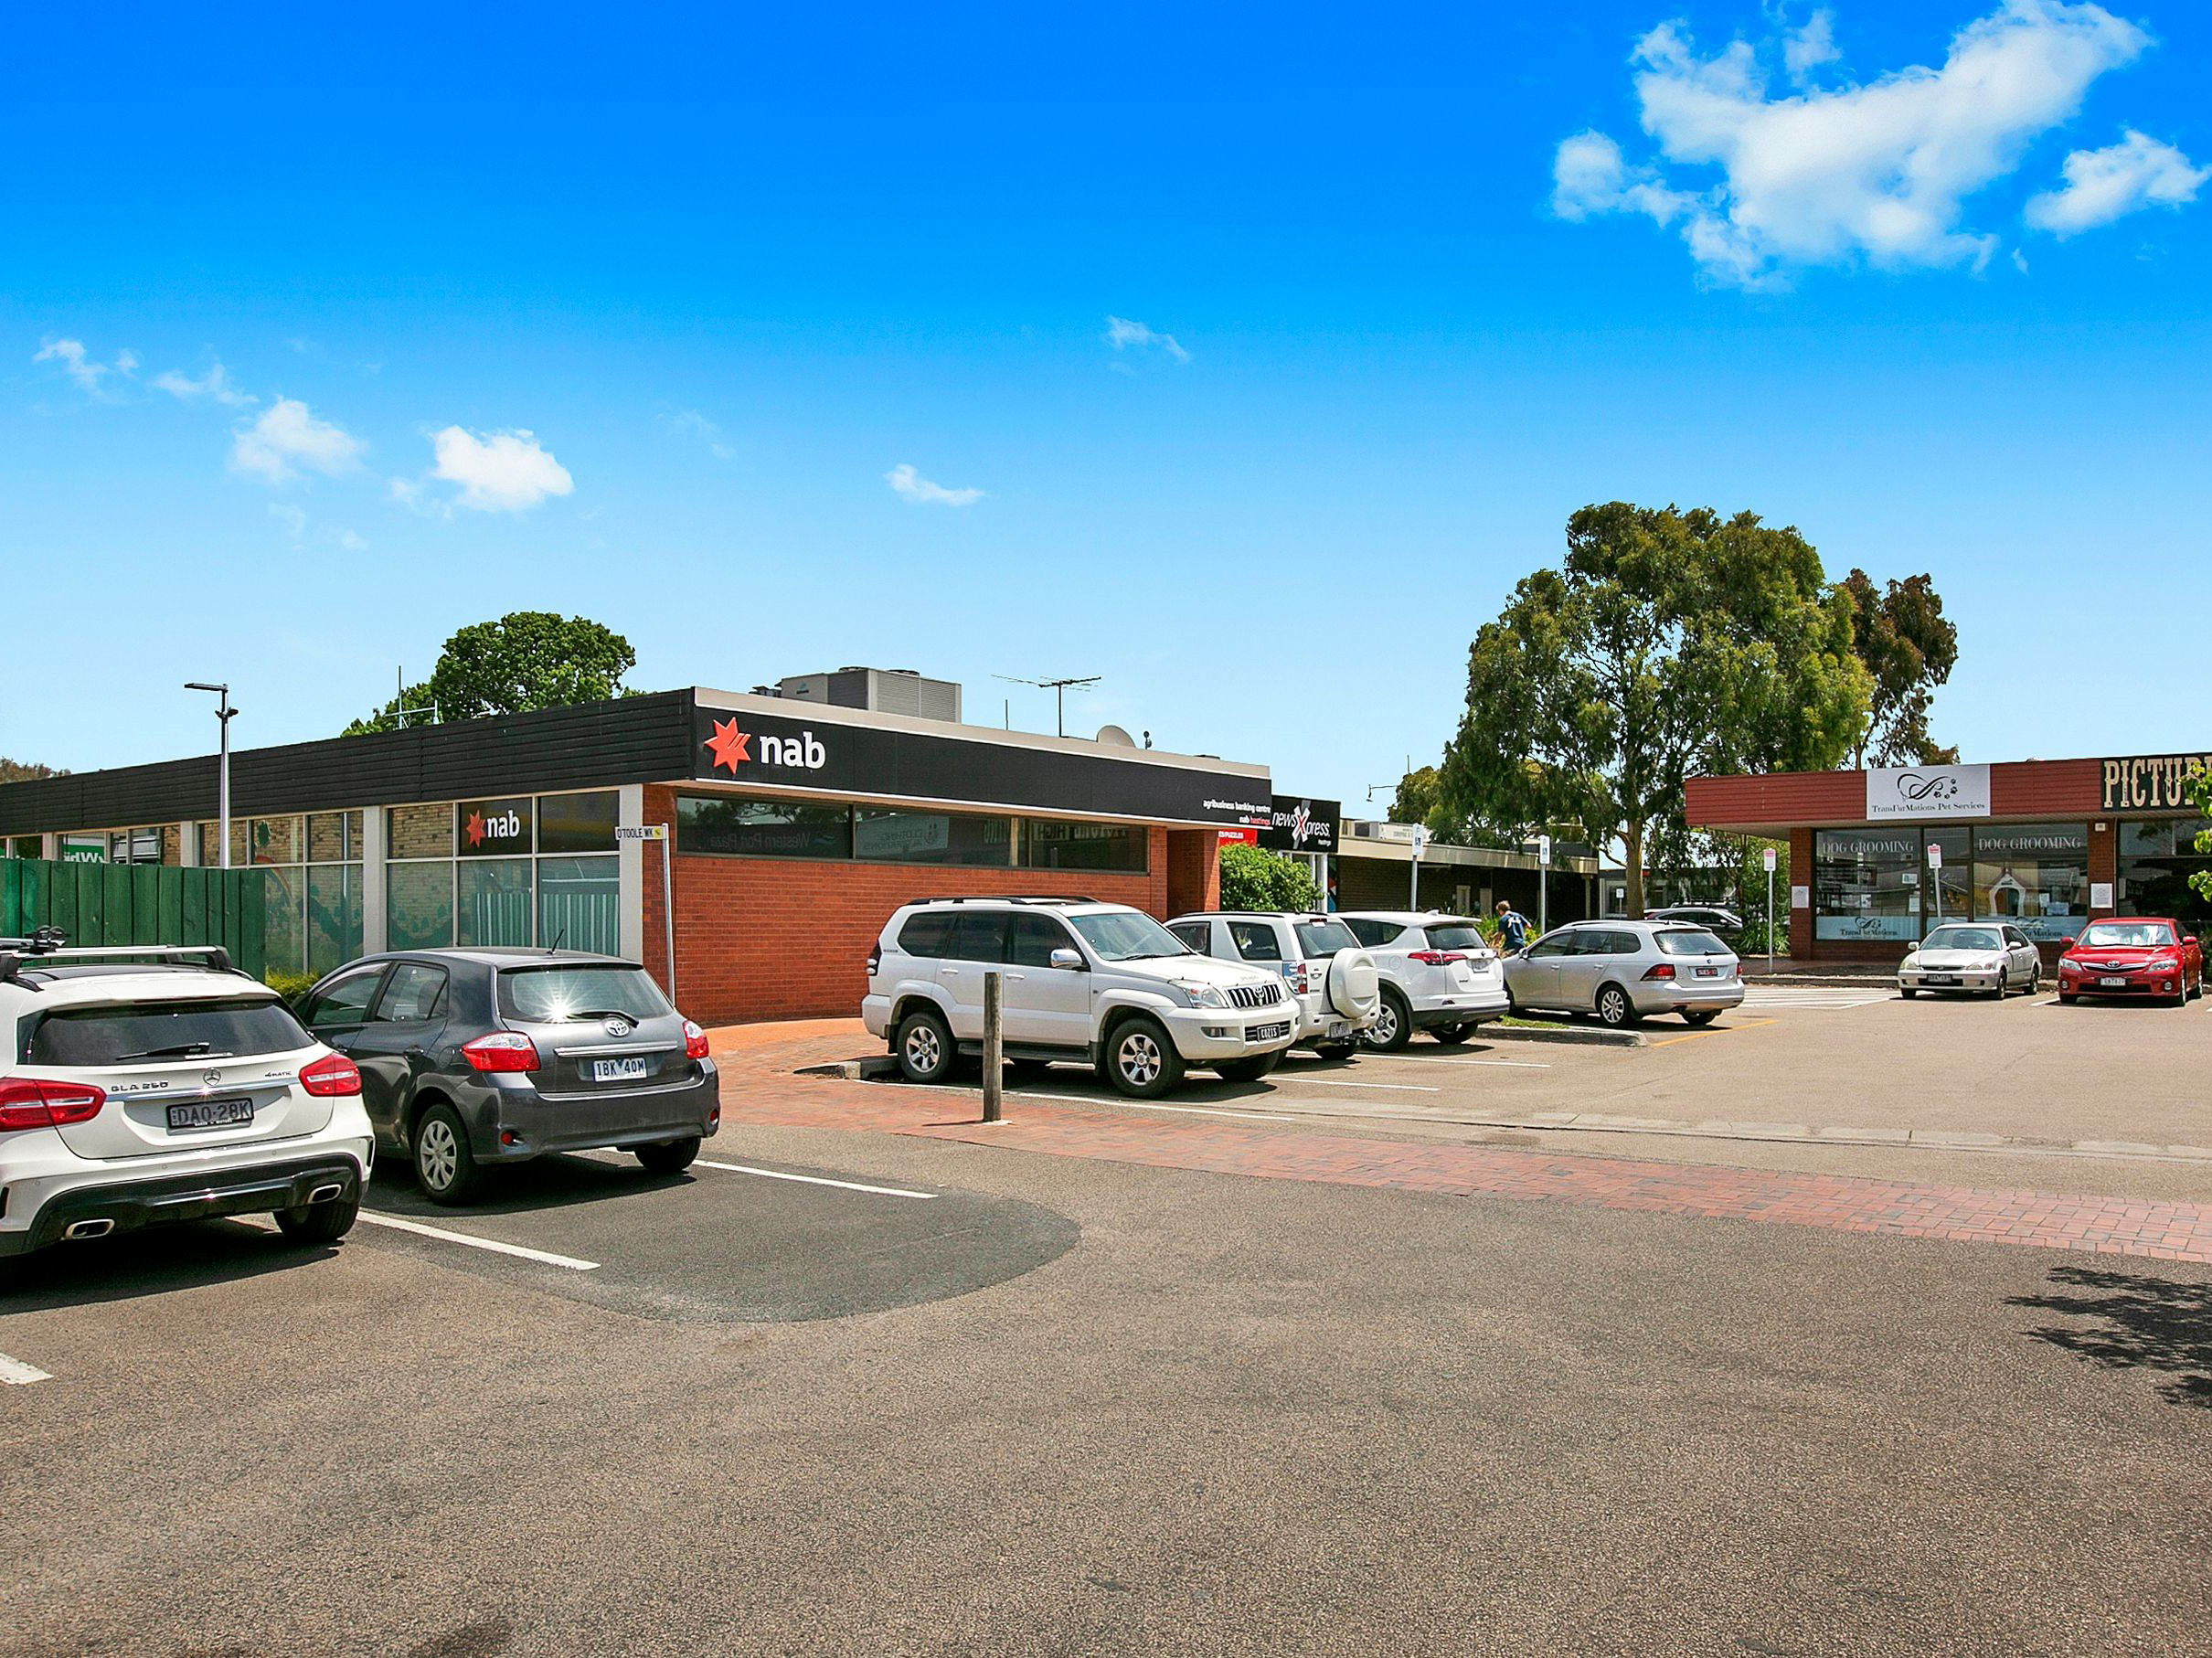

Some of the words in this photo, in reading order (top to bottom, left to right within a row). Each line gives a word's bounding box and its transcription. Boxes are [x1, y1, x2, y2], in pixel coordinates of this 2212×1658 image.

[759, 731, 826, 769] nab
[1203, 799, 1235, 811] agribusiness
[1235, 801, 1255, 813] banking
[1255, 805, 1271, 813] centre
[1938, 802, 1951, 811] Pet
[1954, 801, 1985, 810] Services
[486, 809, 520, 838] nab
[1823, 842, 1847, 853] DOG
[1850, 841, 1914, 853] GROOMING
[1979, 838, 2006, 851] DOG
[2010, 836, 2081, 850] GROOMING
[596, 1061, 617, 1076] 1BK
[111, 1084, 139, 1092] GLA
[142, 1081, 168, 1089] 250
